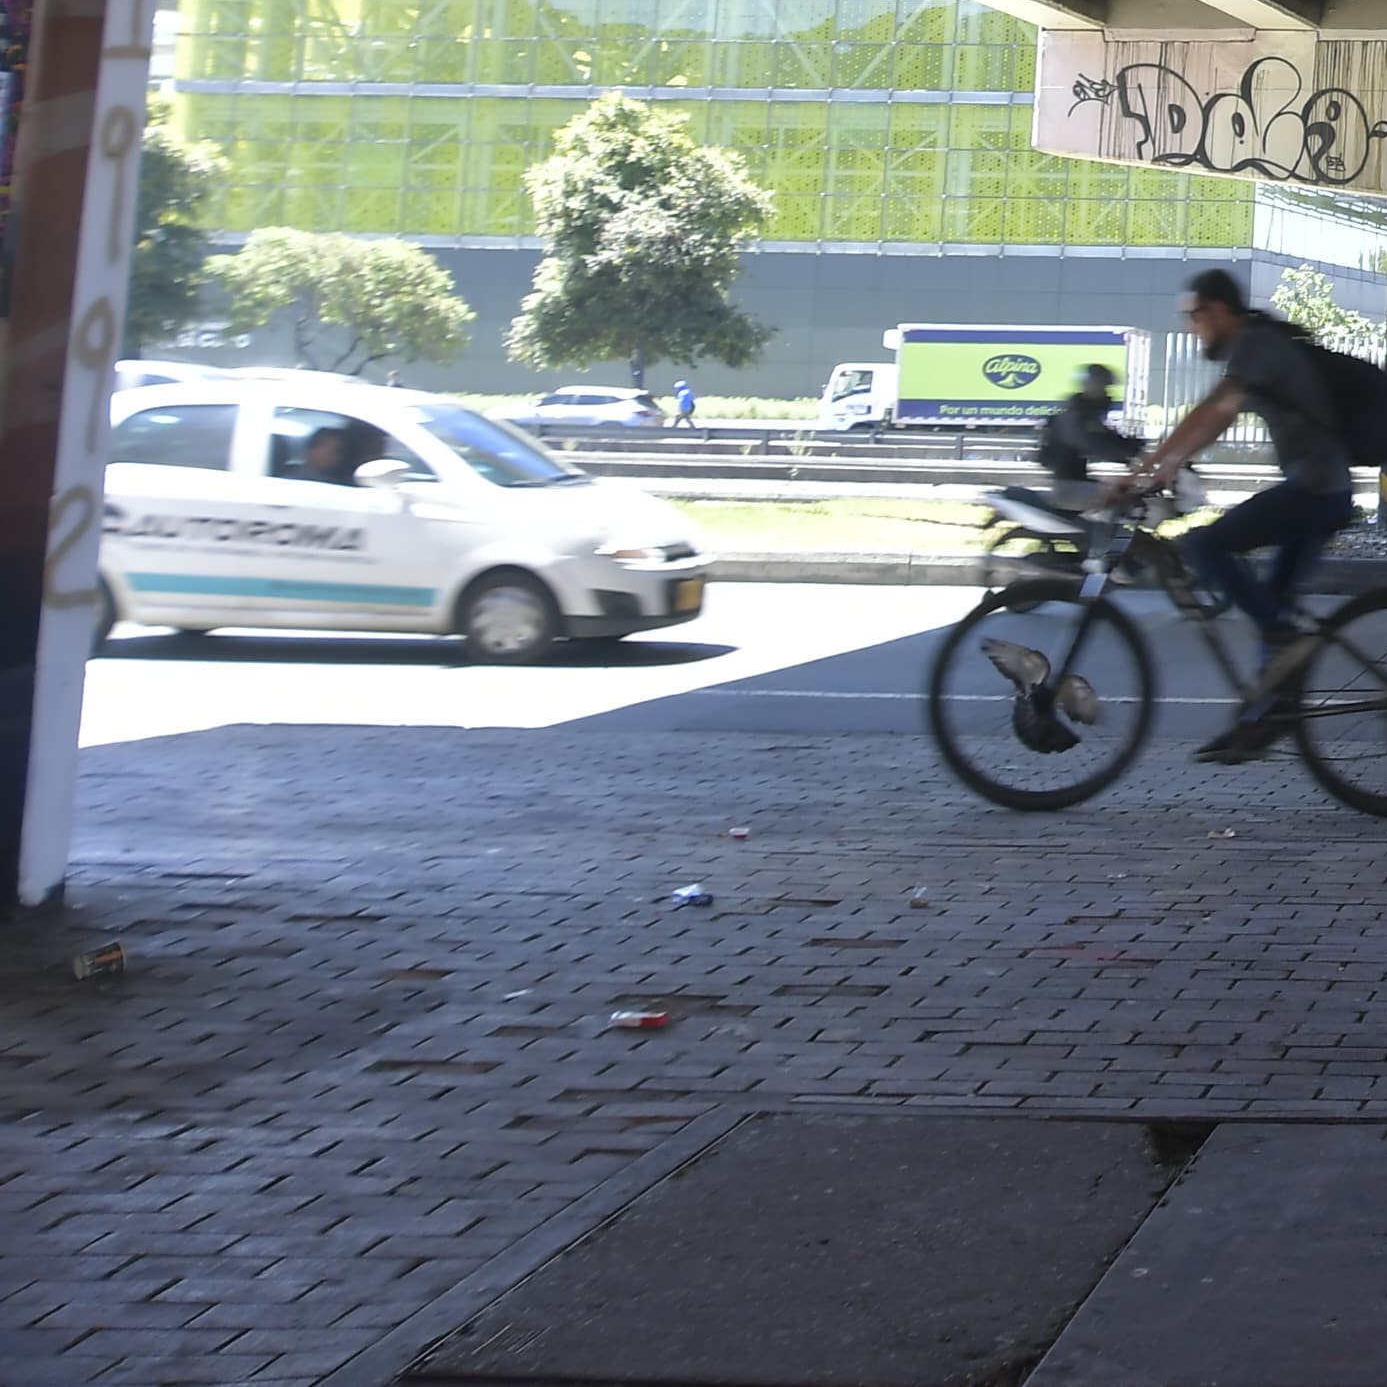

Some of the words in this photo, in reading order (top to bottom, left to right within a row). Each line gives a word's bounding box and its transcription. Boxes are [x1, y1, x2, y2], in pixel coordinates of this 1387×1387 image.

[940, 405, 960, 415] Por
[962, 407, 978, 415] un
[980, 406, 1022, 415] mundo
